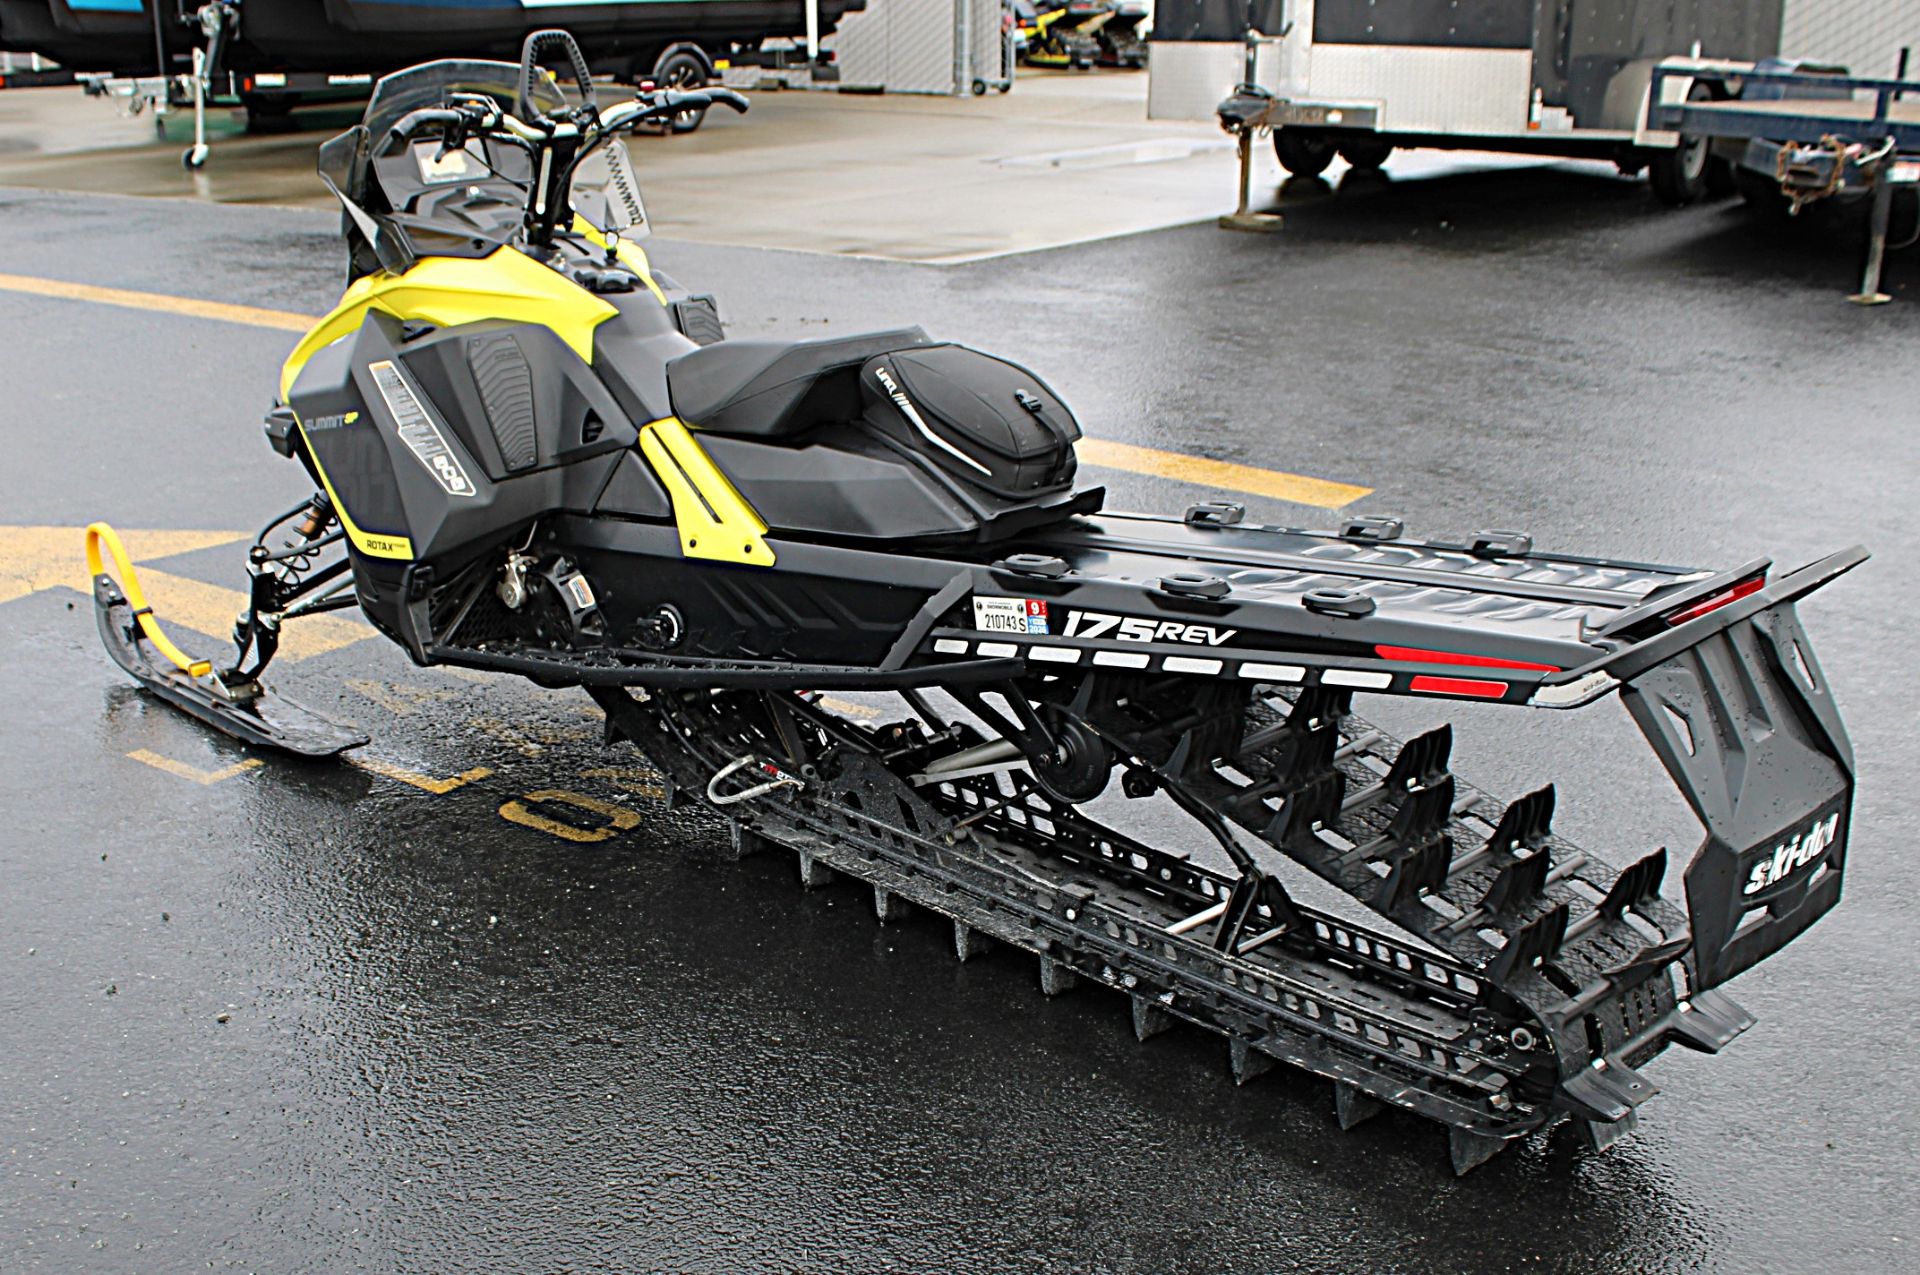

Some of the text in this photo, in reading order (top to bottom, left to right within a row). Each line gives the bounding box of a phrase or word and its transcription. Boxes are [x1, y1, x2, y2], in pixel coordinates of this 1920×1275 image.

[366, 539, 393, 552] ROTAX
[985, 614, 1017, 631] 210743
[1018, 617, 1027, 632] S
